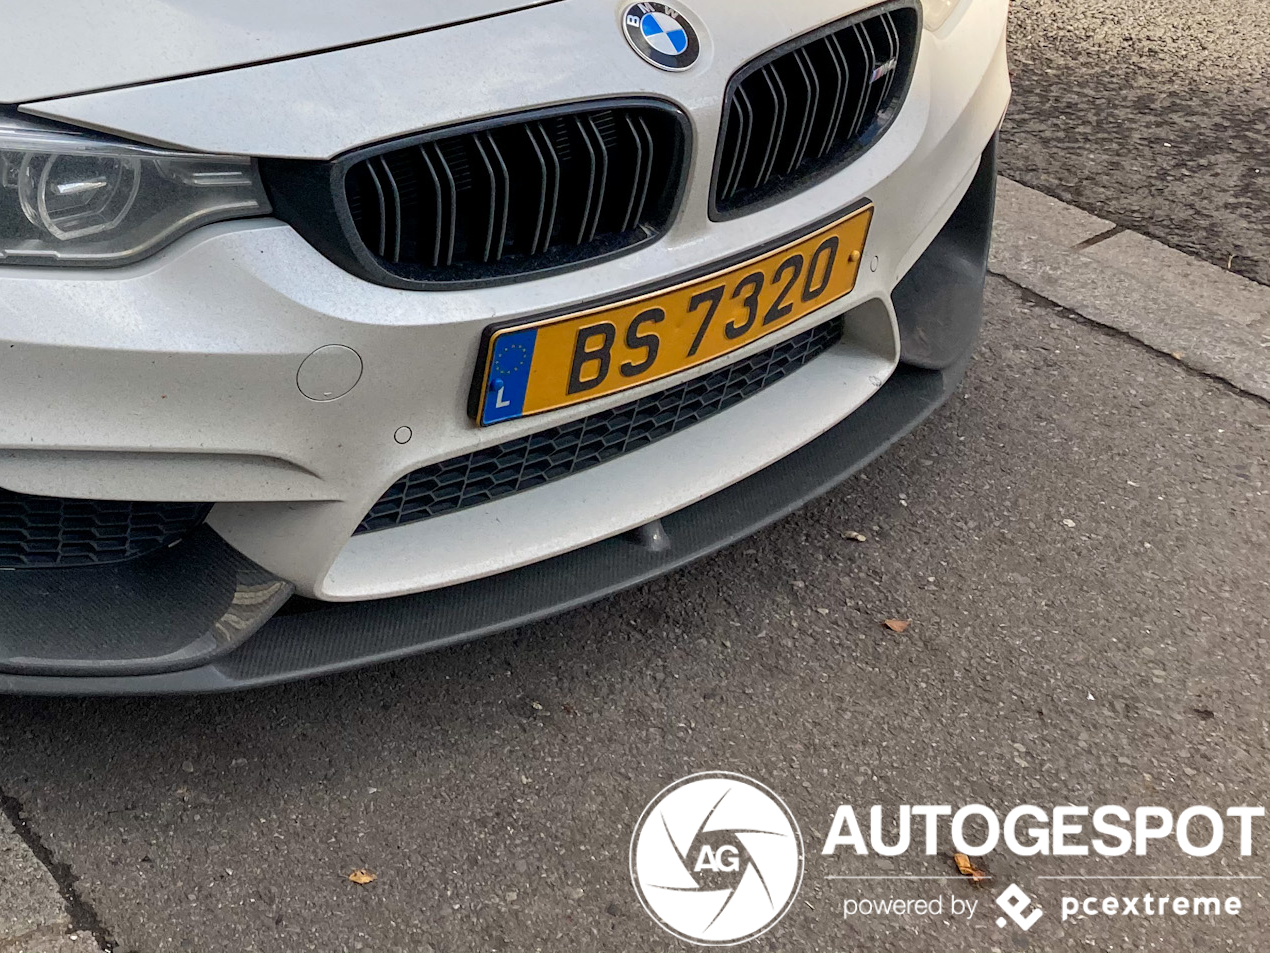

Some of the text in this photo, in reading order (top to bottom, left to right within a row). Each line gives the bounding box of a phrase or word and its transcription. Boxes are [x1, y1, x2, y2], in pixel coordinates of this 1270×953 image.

[626, 1, 680, 28] BMW
[566, 235, 840, 395] BS 7320
[495, 385, 511, 409] L
